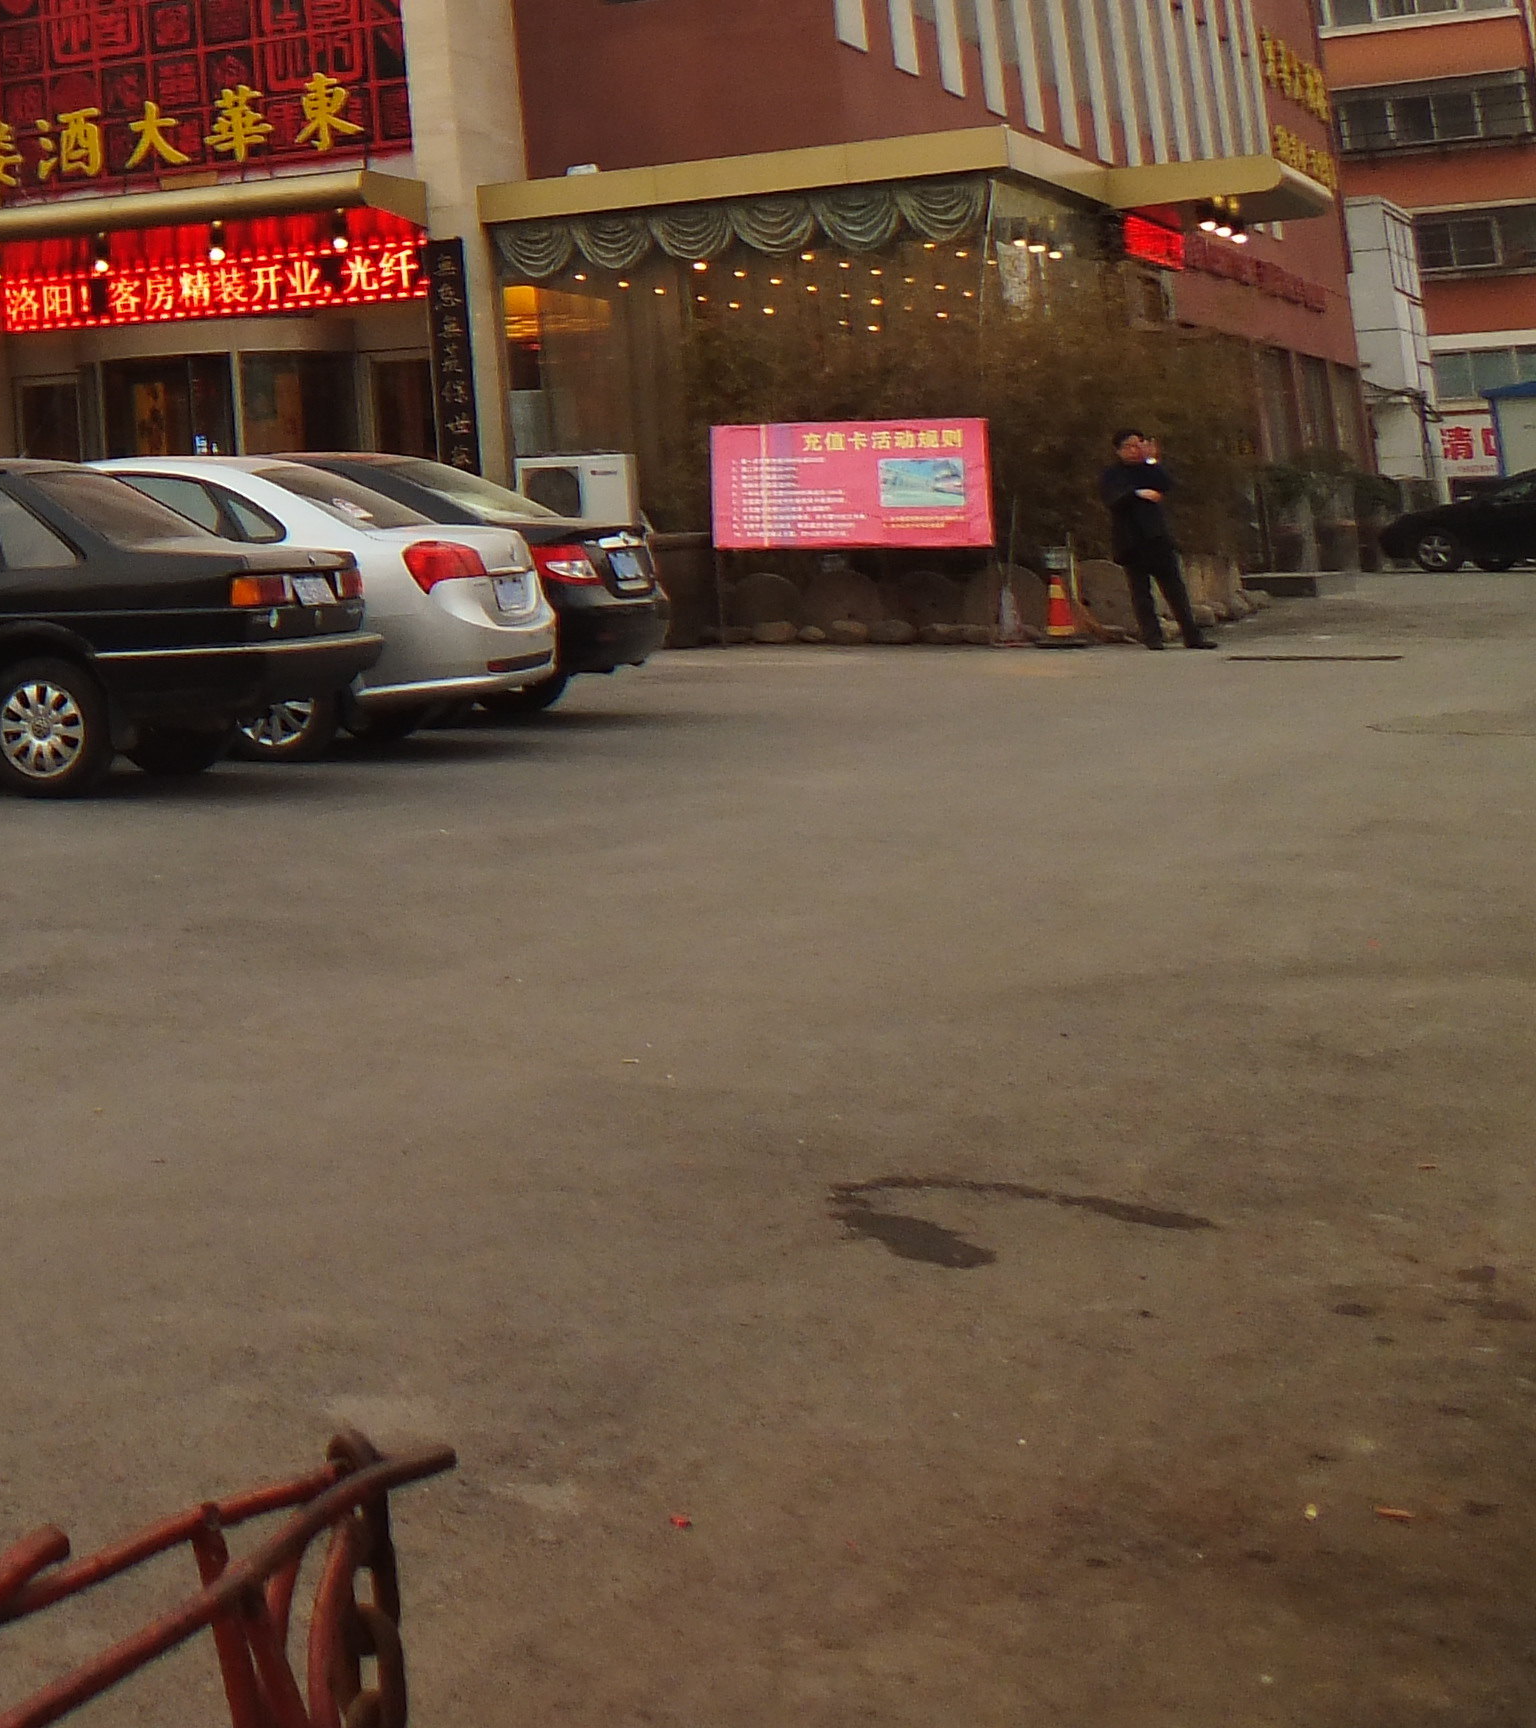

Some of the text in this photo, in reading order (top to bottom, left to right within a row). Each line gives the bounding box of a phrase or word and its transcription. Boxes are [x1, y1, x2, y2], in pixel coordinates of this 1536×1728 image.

[802, 428, 964, 452] 充值卡活动规则
